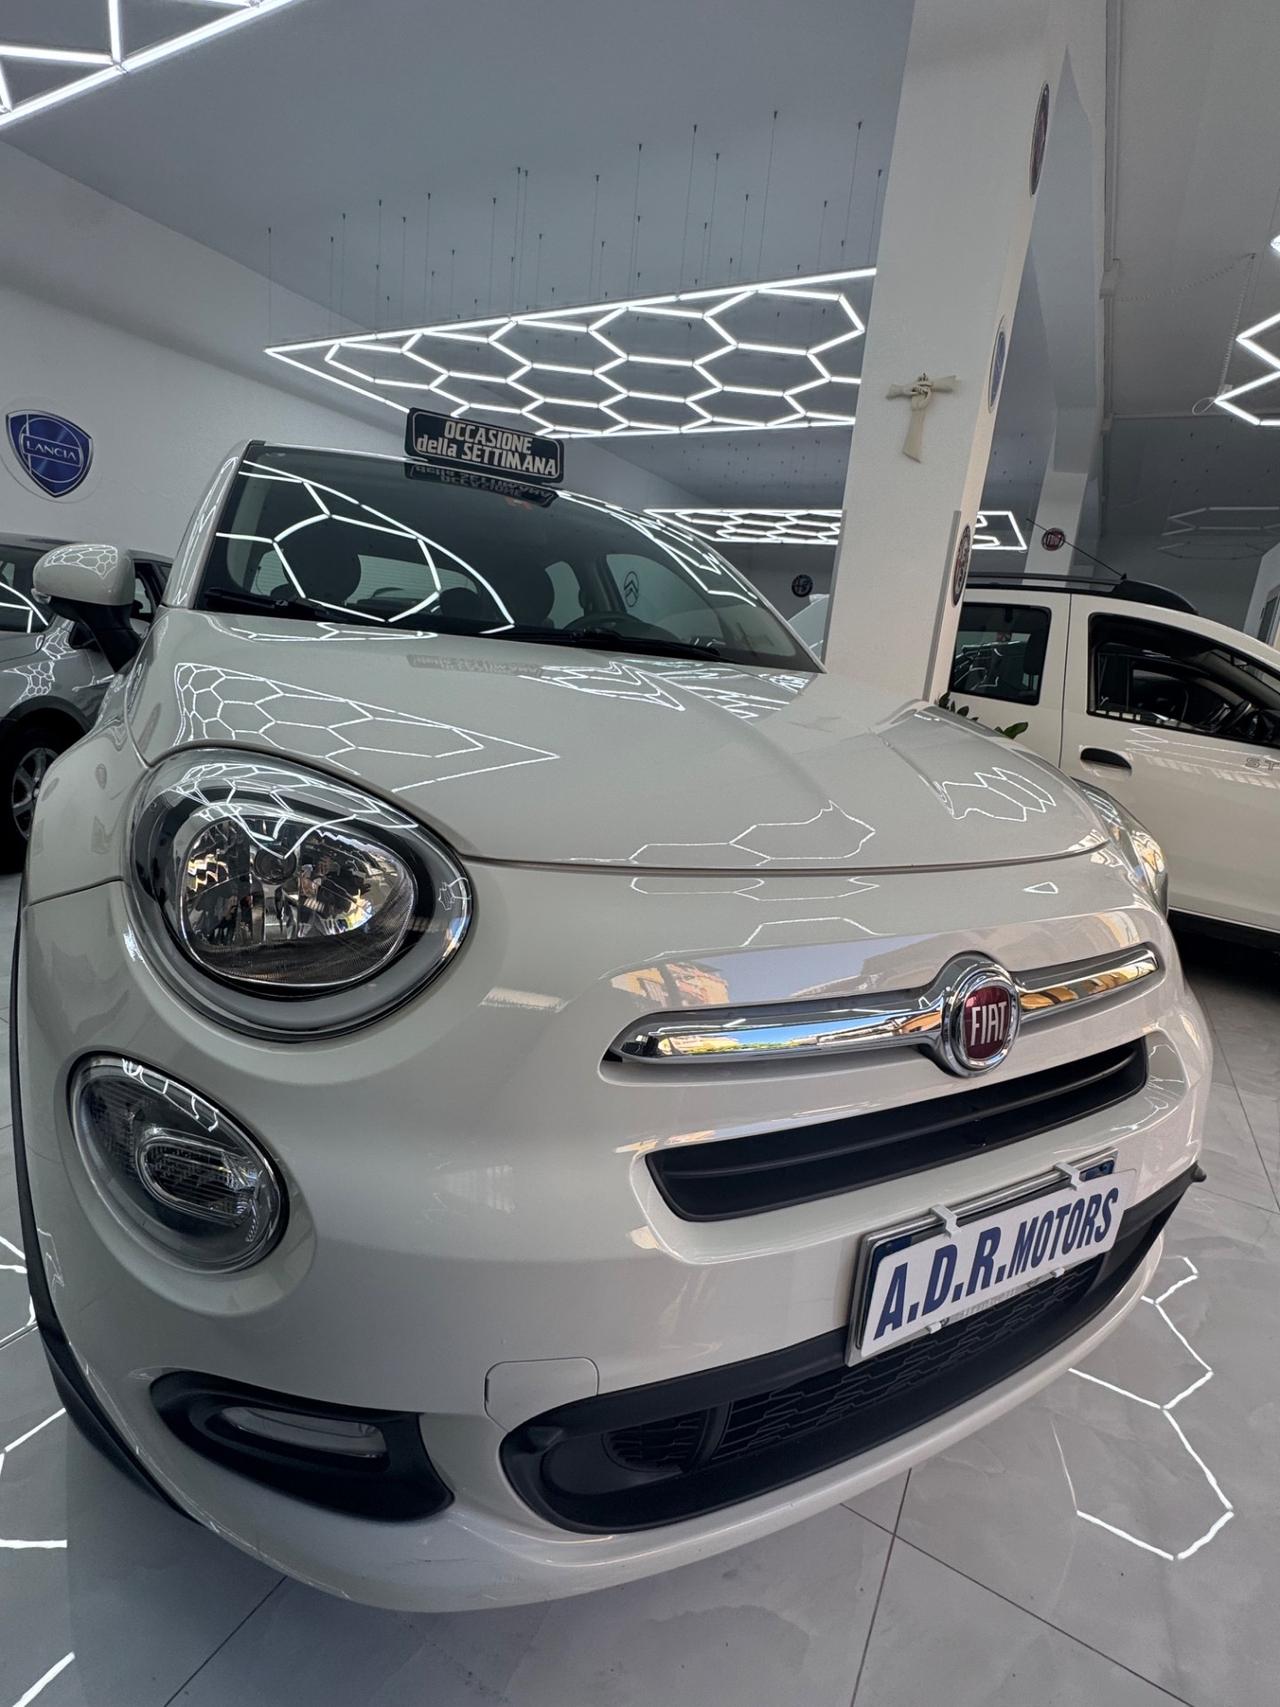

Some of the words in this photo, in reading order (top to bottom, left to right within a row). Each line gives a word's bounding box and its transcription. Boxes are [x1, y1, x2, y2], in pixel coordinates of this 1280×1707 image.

[26, 440, 77, 461] LANCIA
[416, 435, 457, 458] della
[461, 442, 556, 476] SETTIMANA
[444, 421, 533, 454] OCCASIONE
[970, 1001, 1007, 1047] FIAT
